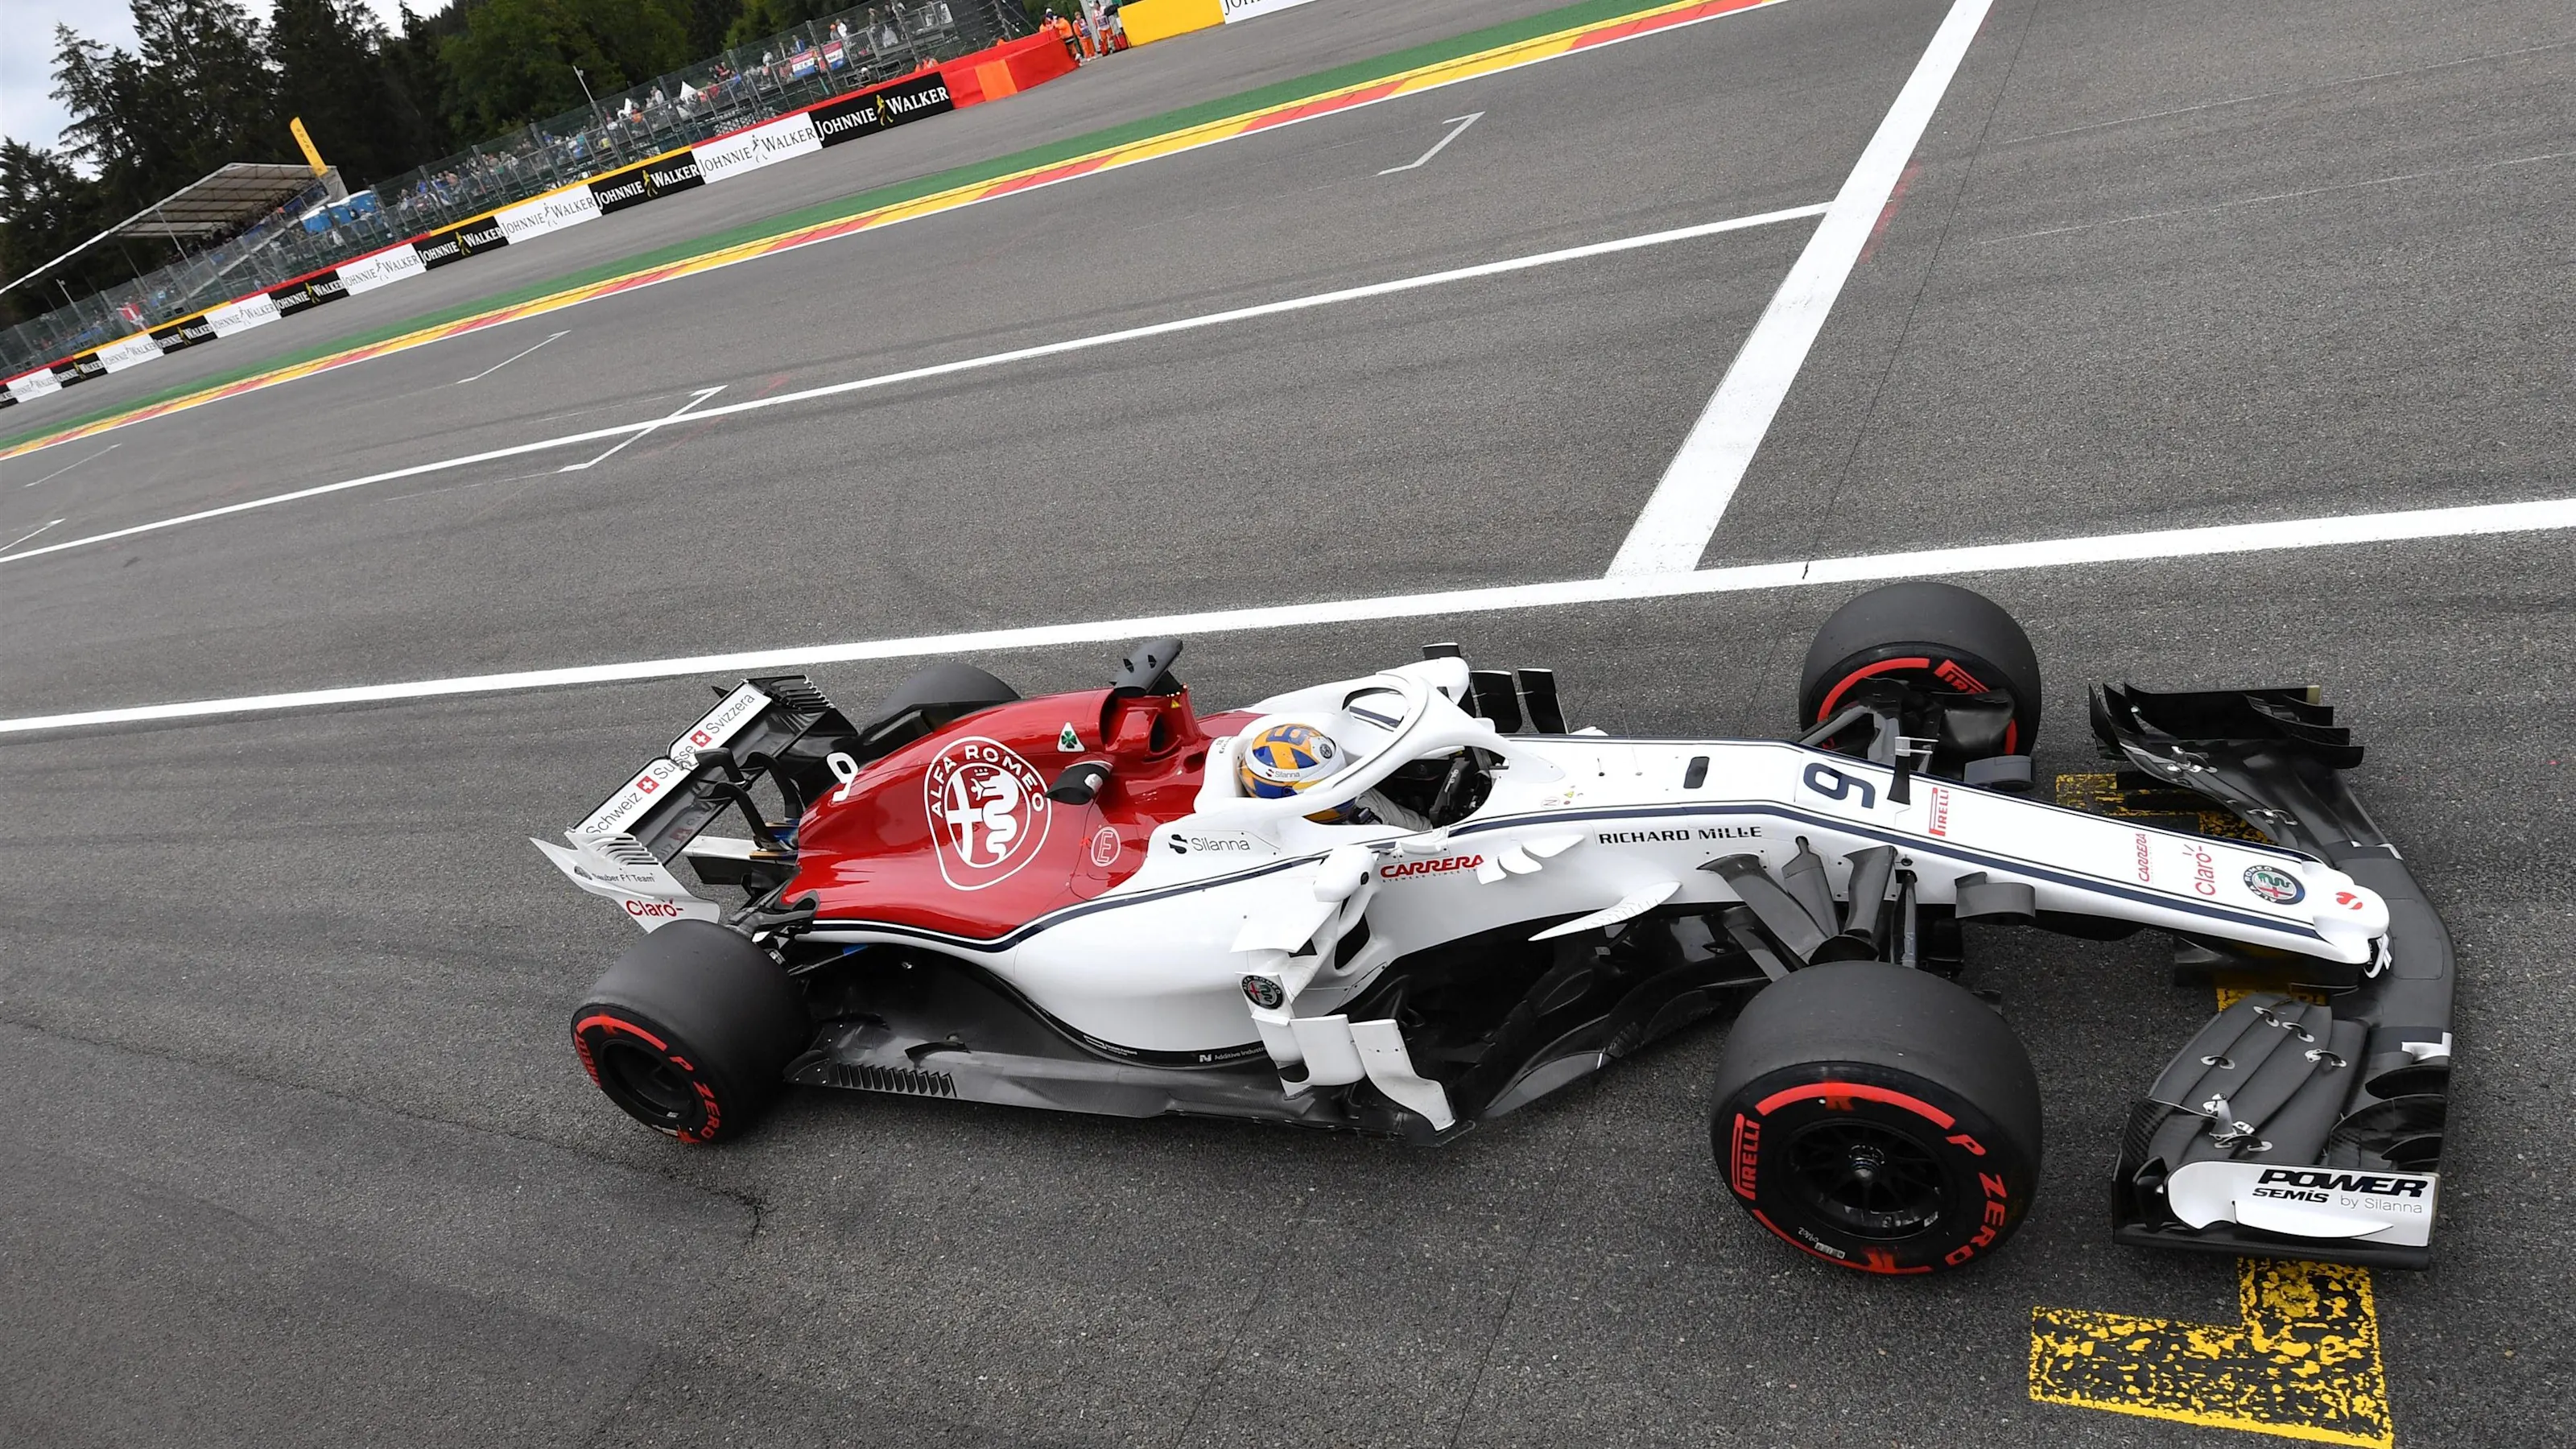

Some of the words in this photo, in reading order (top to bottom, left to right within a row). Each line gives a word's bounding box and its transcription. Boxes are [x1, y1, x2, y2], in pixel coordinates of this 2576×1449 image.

[815, 108, 877, 141] JOHNNIE
[885, 86, 950, 116] WALKER
[699, 147, 753, 176] JOHNNIE
[761, 126, 816, 153] WALKER
[594, 180, 645, 209] JOHNNIE
[650, 163, 701, 188] WALKER
[502, 213, 546, 237] JOHNNIE
[550, 196, 596, 219] WALKER
[418, 240, 460, 266] JOHNNIE
[462, 228, 506, 248] WALKER
[341, 268, 378, 290] JOHNNIE
[382, 254, 419, 274] WALKER
[245, 303, 275, 319] WALKER
[273, 291, 311, 313] JOHNNIE
[312, 281, 344, 297] WALKER
[585, 791, 643, 833] Schweiz
[705, 693, 755, 735] Svizzera
[826, 751, 859, 803] 9
[931, 755, 957, 819] ALFA
[964, 744, 1045, 812] ROMEO
[1802, 762, 1876, 809] 9
[1929, 787, 1949, 836] PIRELLI
[1191, 837, 1251, 852] Silanna
[1599, 830, 1690, 844] RICHARD
[1698, 826, 1762, 840] MILLE
[619, 873, 632, 882] F1
[630, 873, 655, 883] Team
[1380, 854, 1484, 878] CARRERA
[2136, 833, 2150, 882] CARRERA
[2244, 865, 2273, 882] ROMEO
[669, 1055, 694, 1071] P
[692, 1080, 721, 1139] ZERO
[1731, 1113, 1761, 1201] PIRELLI
[1945, 1133, 1987, 1156] P
[2257, 1168, 2428, 1198] POWER
[1944, 1172, 2008, 1266] ZERO
[2339, 1195, 2359, 1210] by
[2363, 1197, 2423, 1215] Silanna
